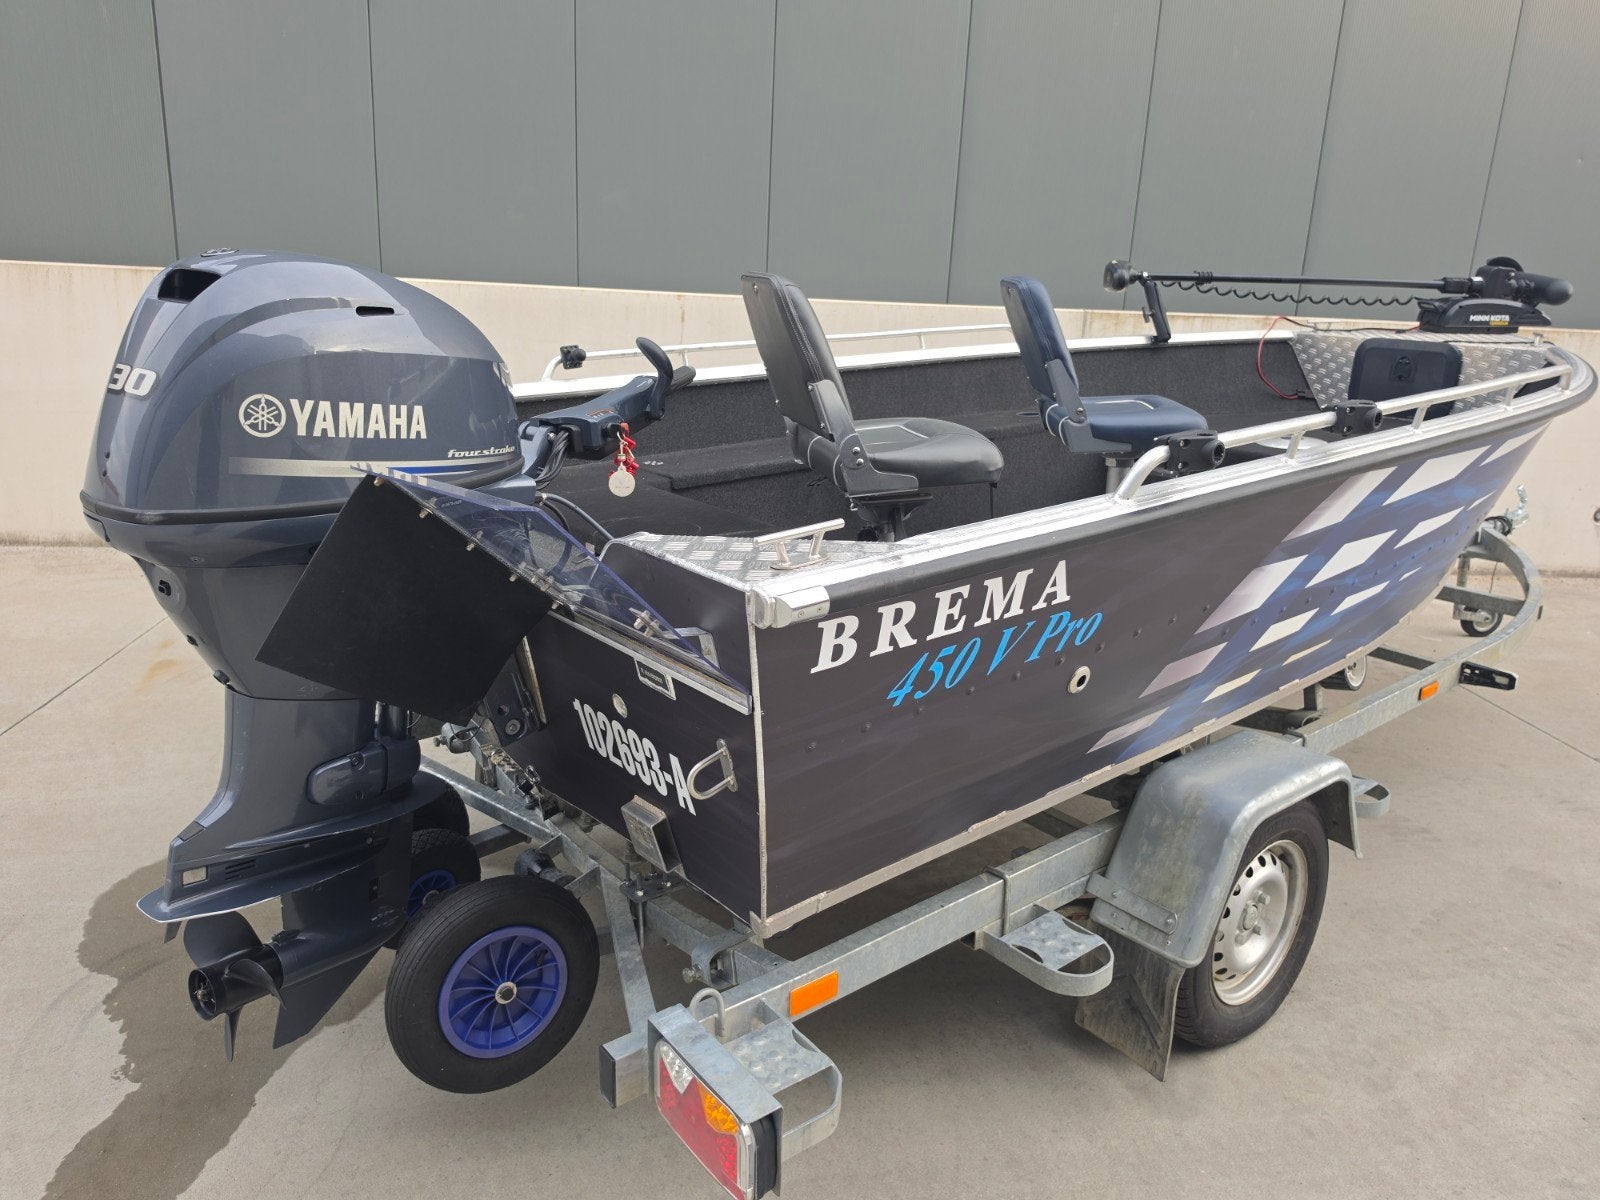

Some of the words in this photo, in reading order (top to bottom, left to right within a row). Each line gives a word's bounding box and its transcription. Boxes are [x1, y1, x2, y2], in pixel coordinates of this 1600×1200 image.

[108, 363, 157, 397] 30
[289, 398, 428, 440] YAMAHA
[809, 559, 1071, 674] BREMA
[886, 637, 981, 707] 450
[986, 620, 1037, 676] V
[1024, 610, 1103, 663] Pro
[572, 698, 697, 816] 102693-A
